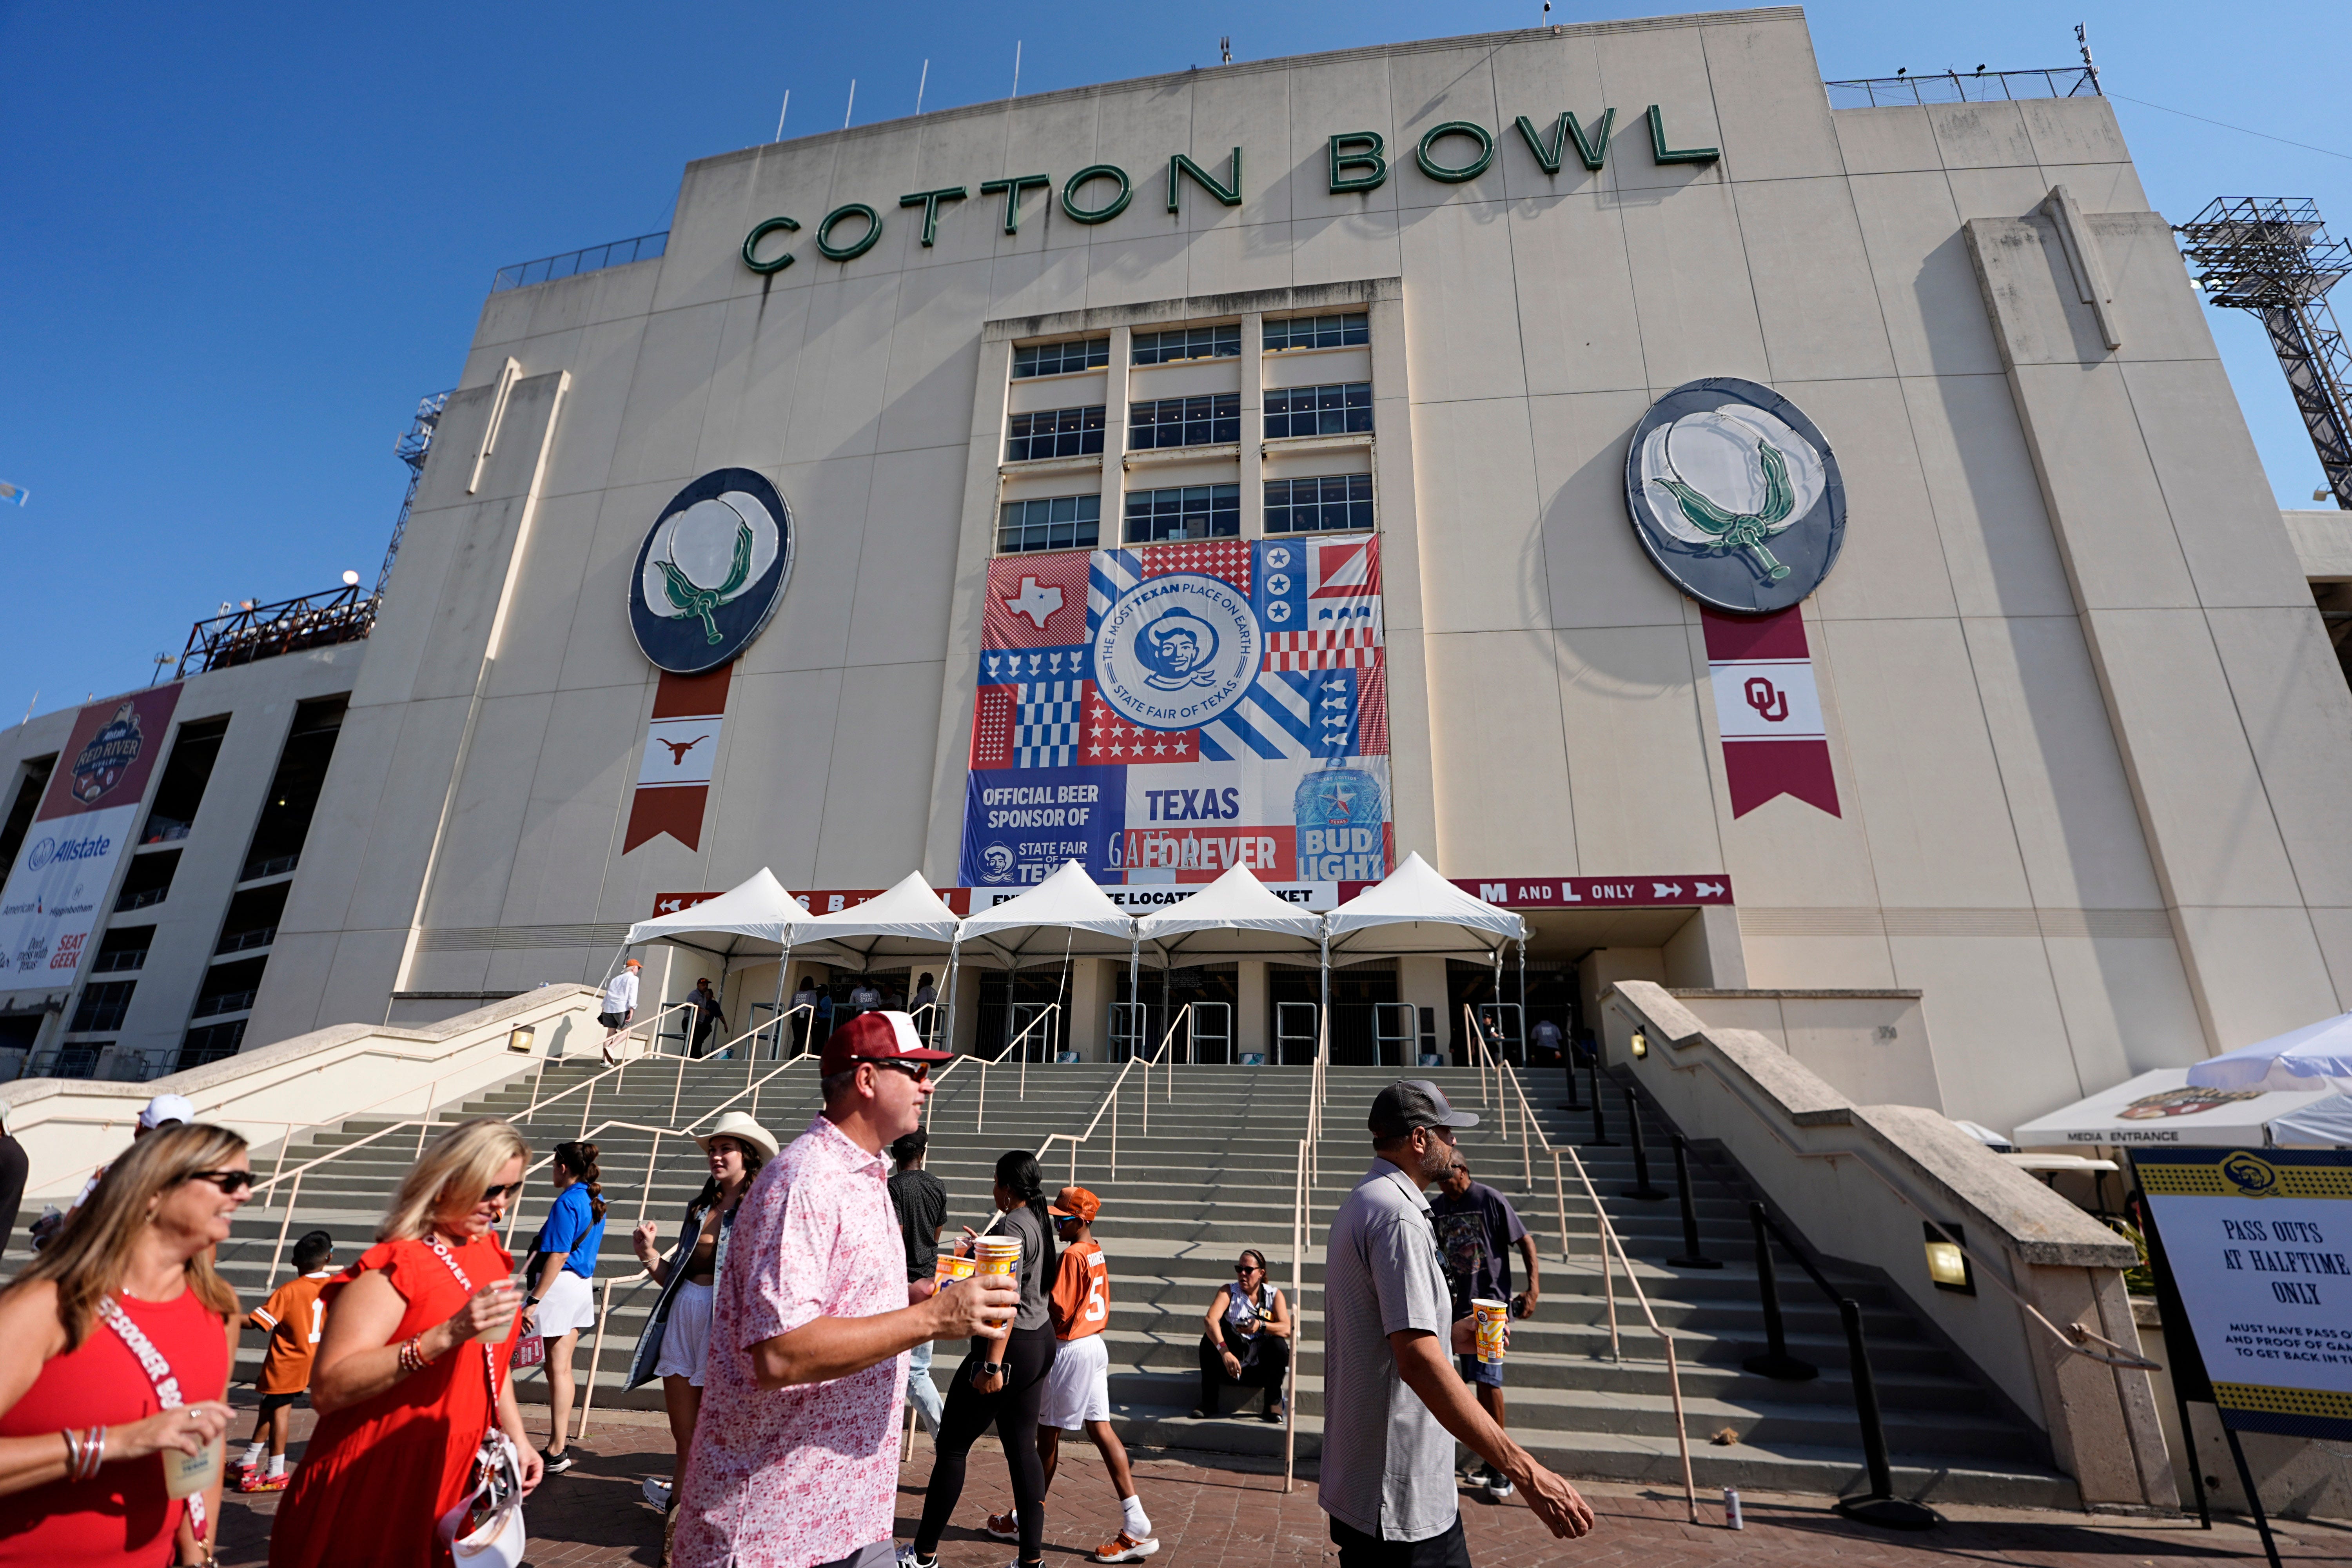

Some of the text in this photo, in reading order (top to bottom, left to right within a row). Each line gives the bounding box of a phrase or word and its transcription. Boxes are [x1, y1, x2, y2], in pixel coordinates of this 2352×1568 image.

[740, 104, 1720, 275] COTTON BOWL
[1103, 583, 1251, 661] THE MOST TEXAN PLACE ON EARTH
[1114, 680, 1237, 719] STATE FAIR OF TEXAS
[1744, 677, 1789, 722] OU
[77, 740, 138, 767] RED RIVER
[91, 758, 117, 769] RIVALRY
[983, 785, 1098, 806] OFFICIAL BEER
[1145, 787, 1239, 821] TEXAS
[987, 808, 1090, 828] SPONSOR OF
[50, 835, 110, 864] Allstate
[1019, 841, 1087, 856] STATE FAIR
[1108, 830, 1197, 867] GATE A
[1143, 837, 1276, 870] FOREVER
[1305, 828, 1373, 855] BUD
[1018, 862, 1086, 883] TEX
[1299, 855, 1381, 882] LIGHT
[827, 895, 845, 912] B
[1129, 892, 1198, 905] LOCAT
[1479, 882, 1635, 902] M AND L ONLY
[3, 903, 34, 916] American
[49, 904, 94, 918] Higginbotham
[58, 933, 87, 951] SEAT
[50, 951, 81, 969] GEEK
[2067, 1131, 2179, 1142] MEDIA ENTRANCE
[2222, 1219, 2323, 1243] PASS OUTS
[423, 1234, 472, 1291] OOMER
[2223, 1249, 2351, 1275] AT HALFTIME
[1085, 1276, 1106, 1321] 5
[2271, 1281, 2321, 1305] ONLY
[309, 1298, 324, 1343] 1
[2230, 1323, 2264, 1333] MUST
[2267, 1325, 2303, 1336] HAVE
[2305, 1327, 2338, 1339] PASS
[107, 1313, 170, 1382] SOONER
[2225, 1335, 2253, 1345] AND
[2256, 1336, 2301, 1348] PROOF
[2305, 1340, 2322, 1350] OF
[2235, 1347, 2253, 1357] TO
[2256, 1348, 2279, 1359] GET
[2283, 1351, 2321, 1362] BACK
[2322, 1354, 2339, 1363] IN
